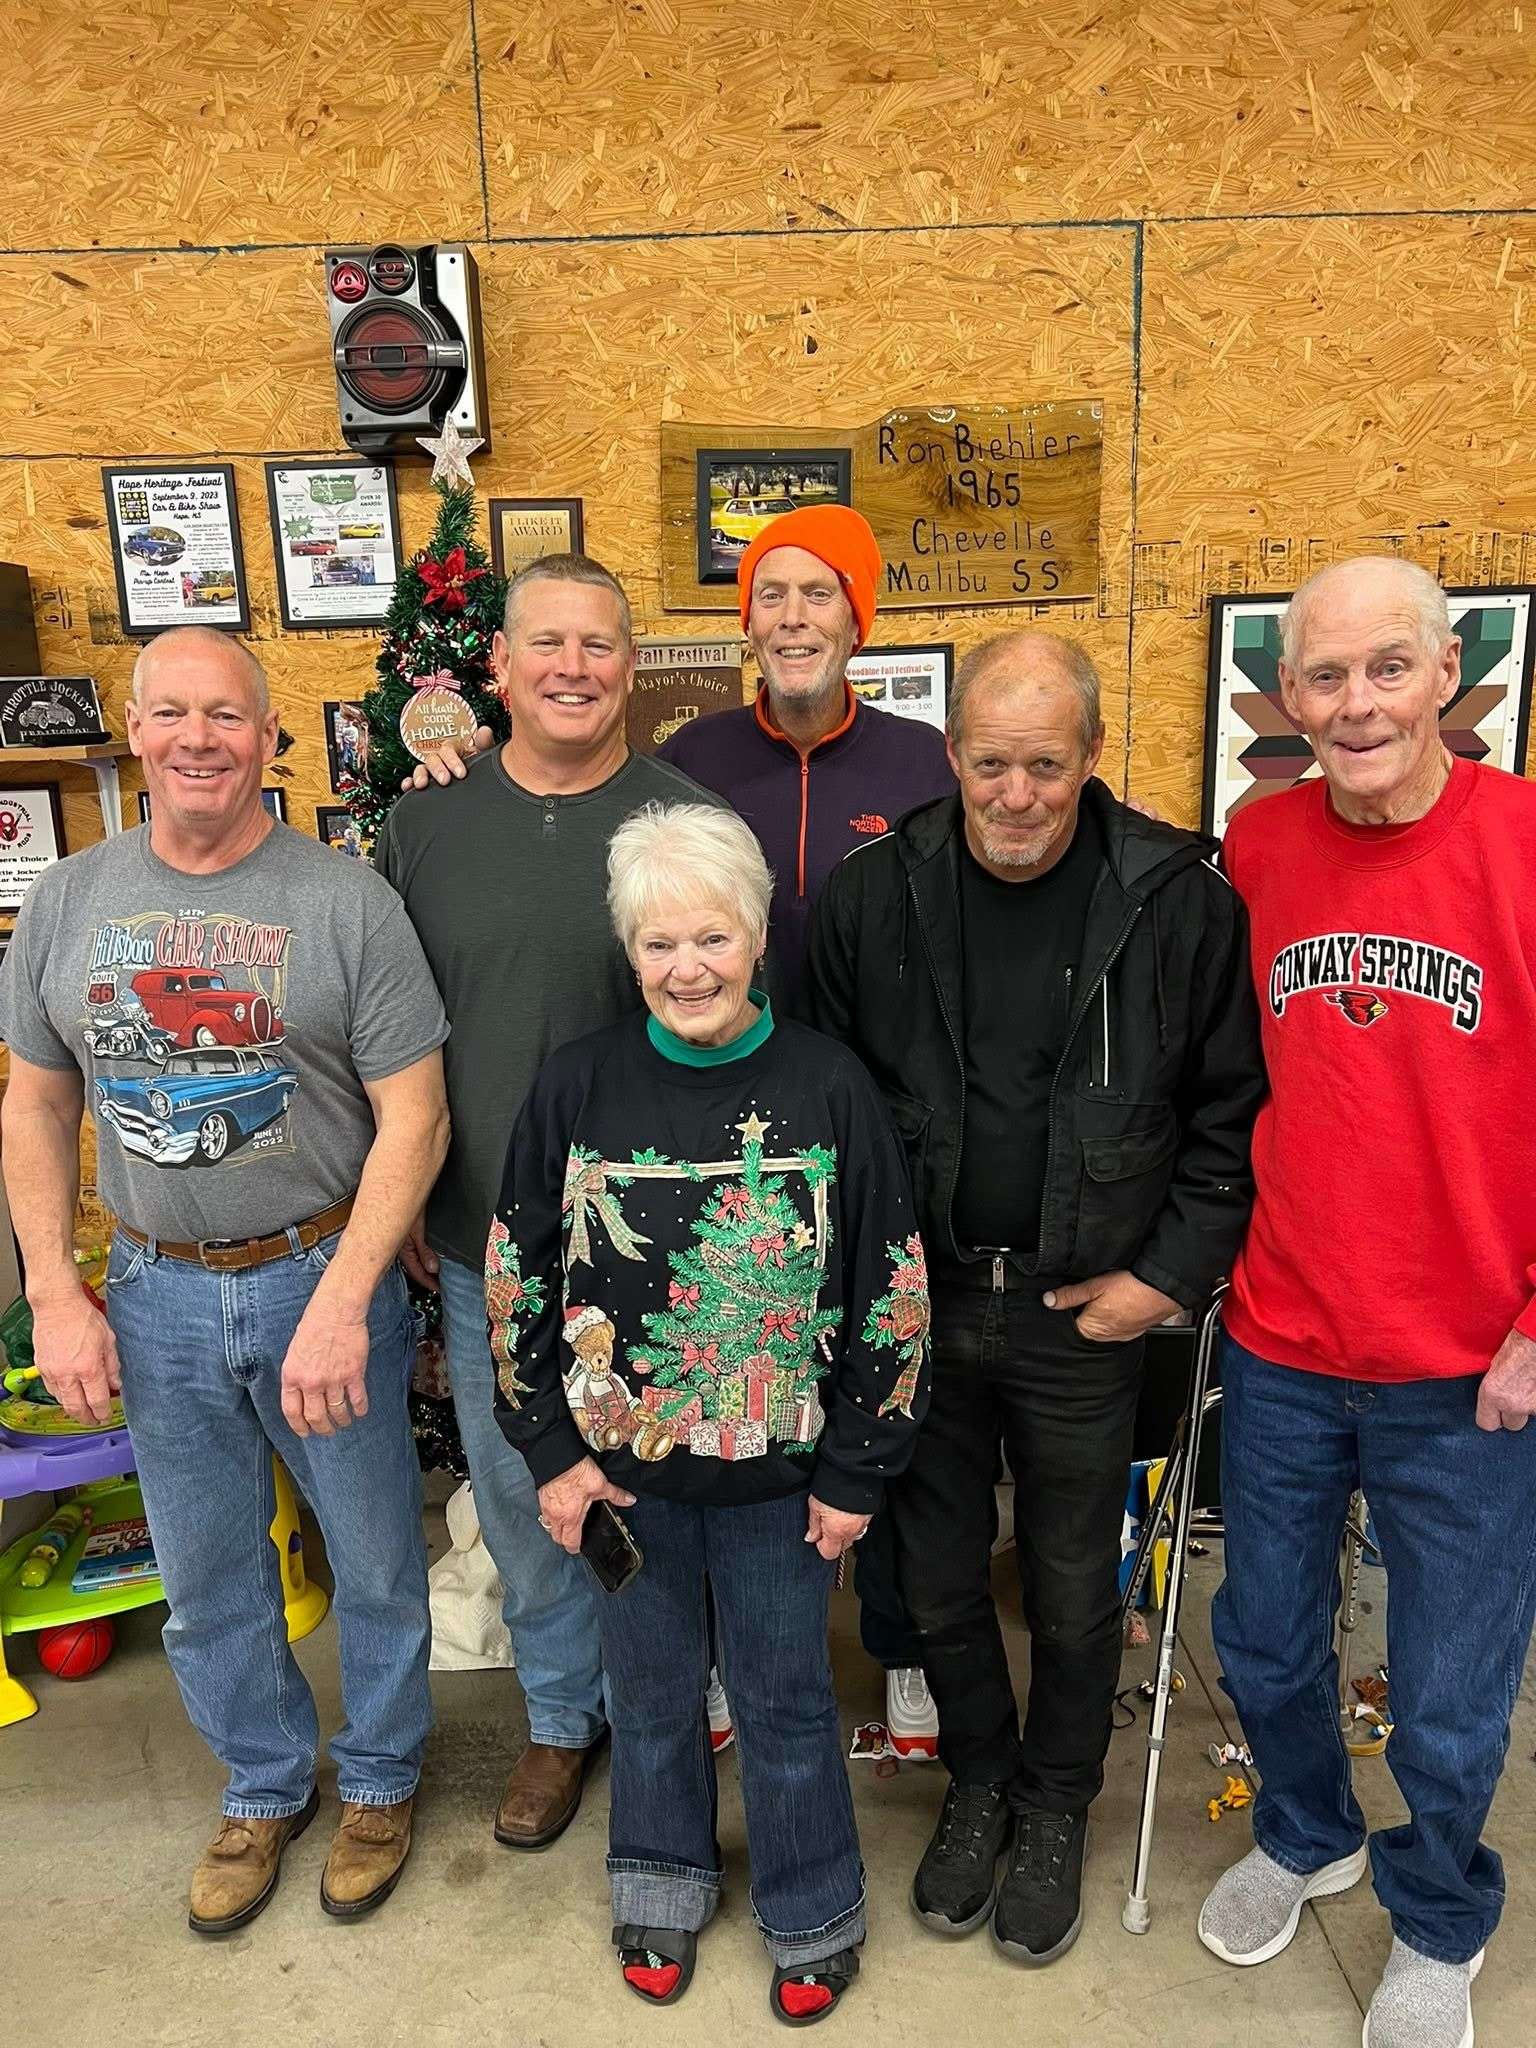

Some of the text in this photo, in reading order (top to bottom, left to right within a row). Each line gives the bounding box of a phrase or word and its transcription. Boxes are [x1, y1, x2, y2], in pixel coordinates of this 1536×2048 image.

[878, 422, 1081, 464] Ron Biehler
[118, 476, 223, 491] Hope Heritage Festival
[947, 469, 1021, 509] 1965
[152, 493, 188, 501] September
[201, 491, 218, 499] 2023
[152, 501, 222, 511] Car & Bike Show
[511, 526, 564, 536] AWARD
[912, 518, 1056, 555] Chevelle
[886, 560, 988, 593] Malibu
[636, 646, 727, 664] Fall Festival
[637, 671, 729, 693] Mayor's Choice
[2, 680, 97, 722] THROTTLE JOCKEYS
[415, 696, 460, 714] All hearts
[423, 714, 454, 724] come
[410, 723, 458, 742] HOME
[20, 855, 49, 863] Choice
[90, 919, 292, 971] Hillsboro CAR SHOW
[91, 973, 115, 982] ROUTE
[1269, 932, 1484, 1034] CONWAY SPRINGS
[252, 1135, 284, 1150] 2022
[253, 1128, 272, 1140] JUNE
